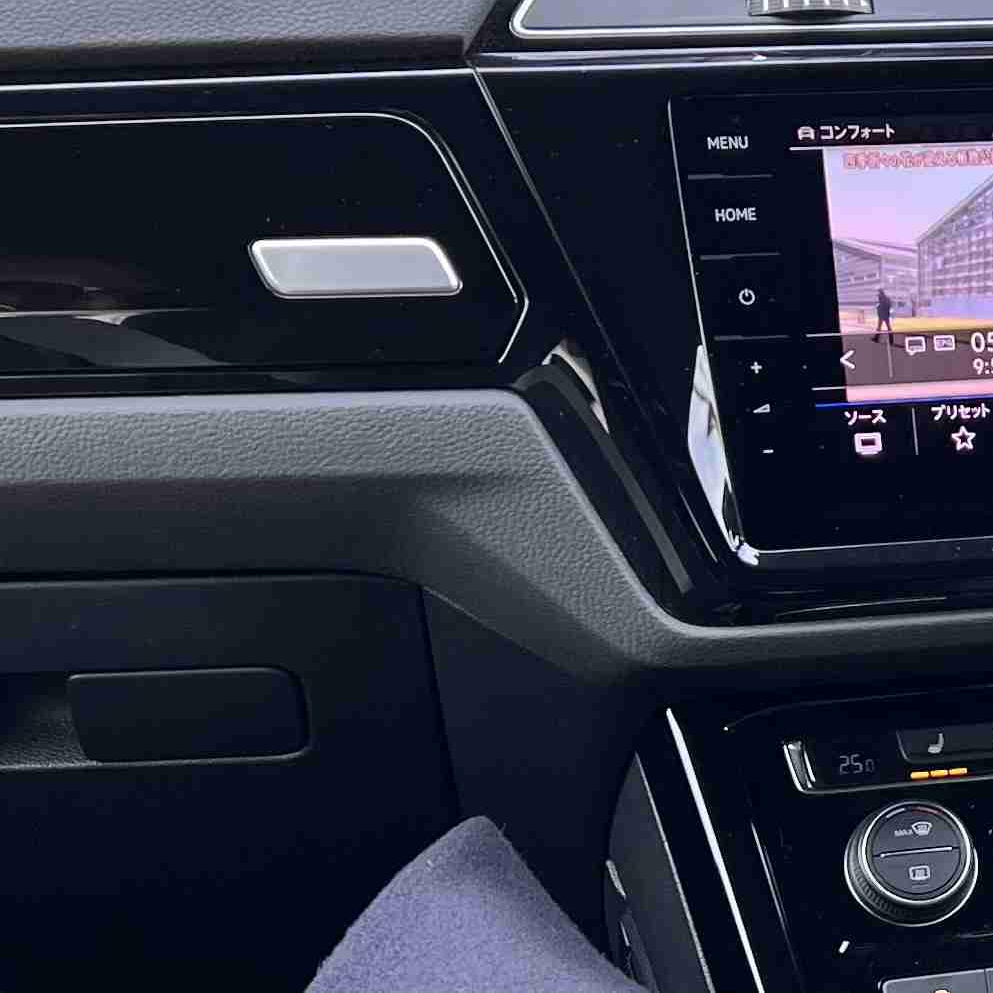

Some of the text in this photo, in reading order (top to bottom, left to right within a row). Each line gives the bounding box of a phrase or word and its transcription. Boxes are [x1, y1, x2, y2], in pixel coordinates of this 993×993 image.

[820, 123, 895, 140] コンフォート
[707, 135, 749, 150] MENU
[714, 207, 757, 222] HOME
[844, 409, 887, 425] ソース
[931, 403, 991, 420] プリセット
